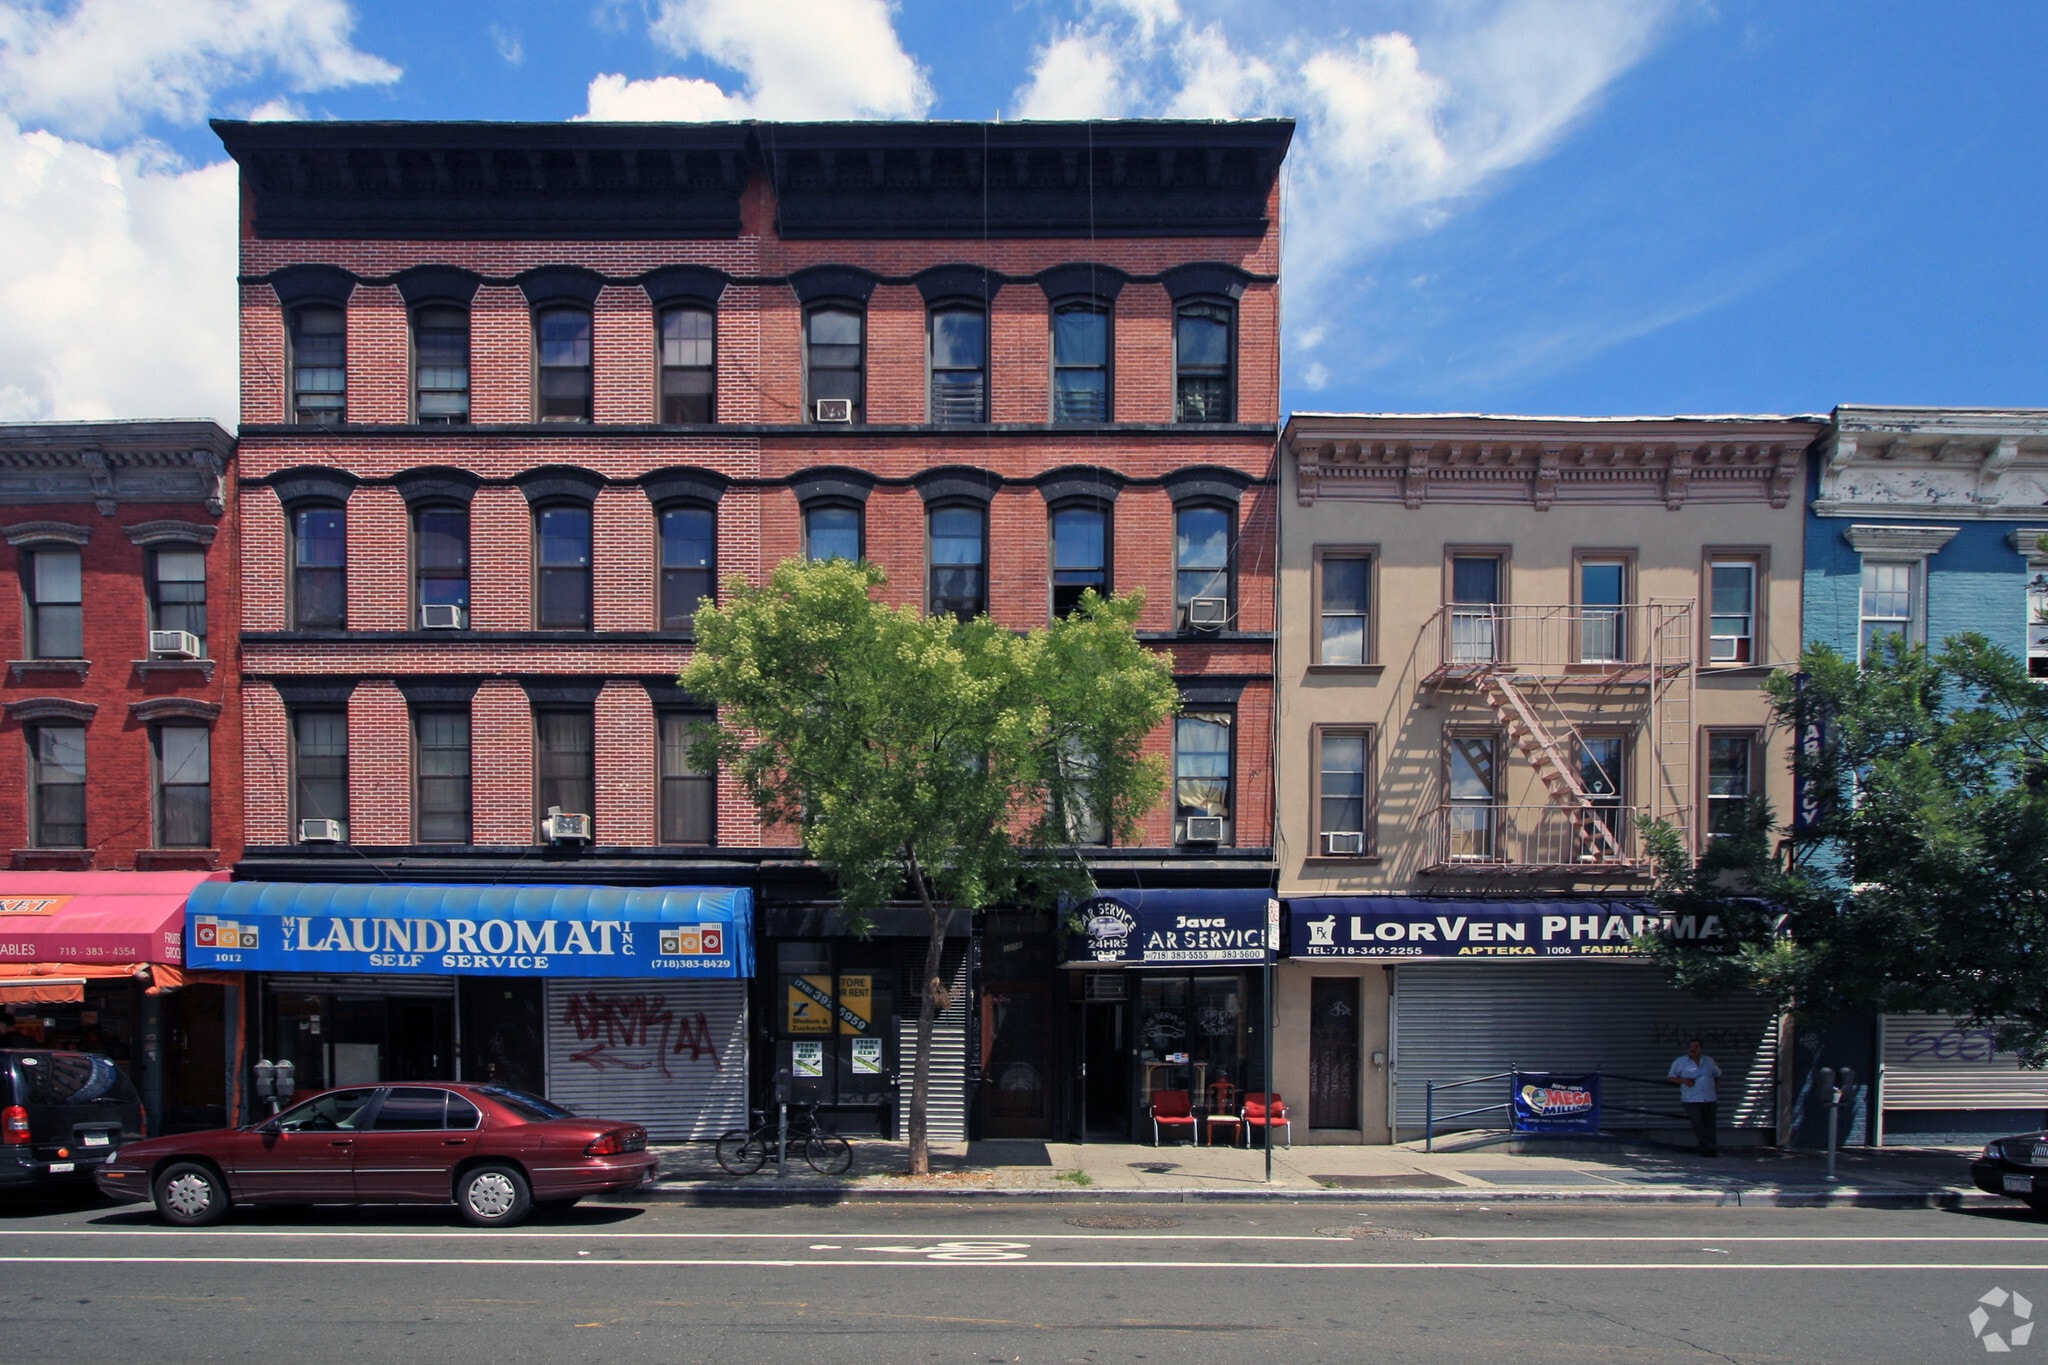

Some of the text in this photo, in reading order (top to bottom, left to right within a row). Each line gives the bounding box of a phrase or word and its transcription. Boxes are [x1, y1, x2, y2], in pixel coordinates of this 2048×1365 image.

[1098, 903, 1137, 933] SERVICE
[1176, 916, 1226, 928] Java
[296, 917, 621, 955] LAUNDROMAT
[1143, 931, 1178, 949] AR
[0, 943, 35, 956] ABLES
[112, 947, 136, 955] 4354
[1088, 939, 1129, 949] 24HRS
[1458, 946, 1537, 955] APTEKA
[1546, 946, 1571, 954] 1006
[214, 954, 242, 962] 1012
[369, 954, 549, 969] SELF SERVICE
[841, 978, 865, 987] TORE
[849, 988, 869, 997] RENT
[1544, 1088, 1592, 1107] MEGA
